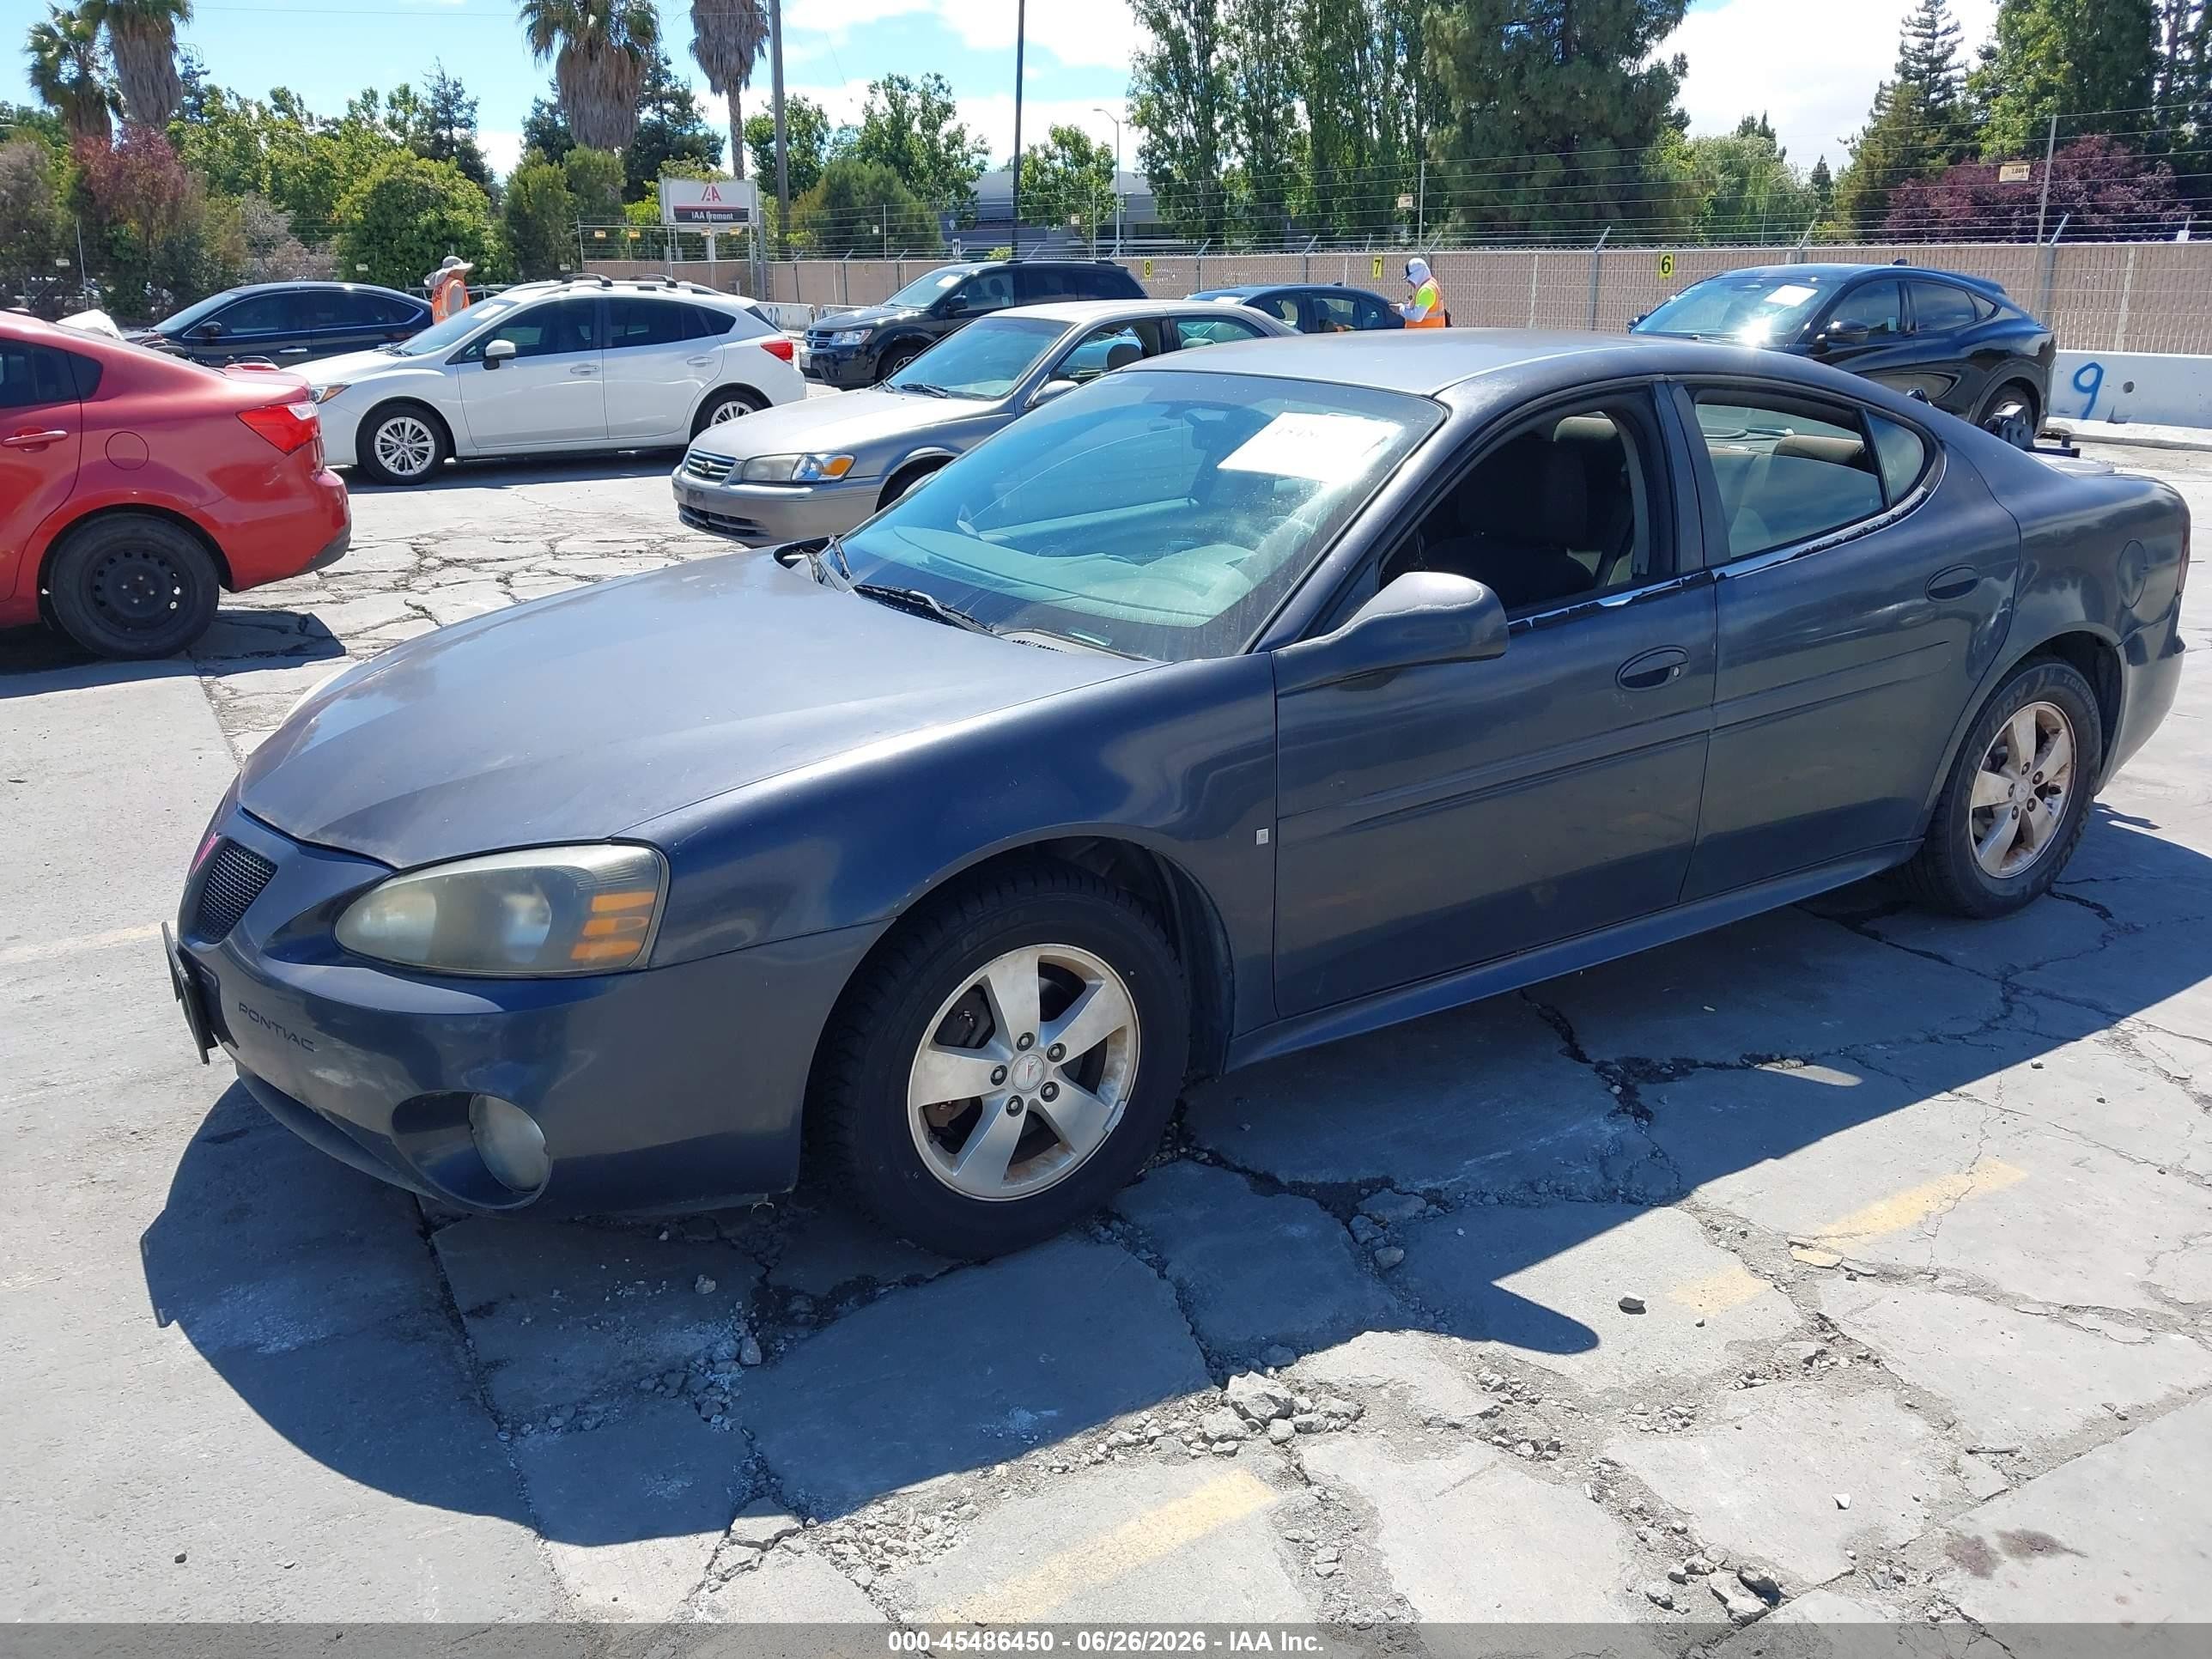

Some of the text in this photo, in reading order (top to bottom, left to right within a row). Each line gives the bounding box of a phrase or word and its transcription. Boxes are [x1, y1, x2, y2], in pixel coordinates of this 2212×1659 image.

[691, 211, 733, 221] IAA Fremont
[1146, 262, 1150, 276] 8
[1375, 259, 1381, 275] 7
[1662, 255, 1671, 274] 6
[2073, 362, 2104, 420] 9
[239, 1001, 318, 1053] PONTIAC
